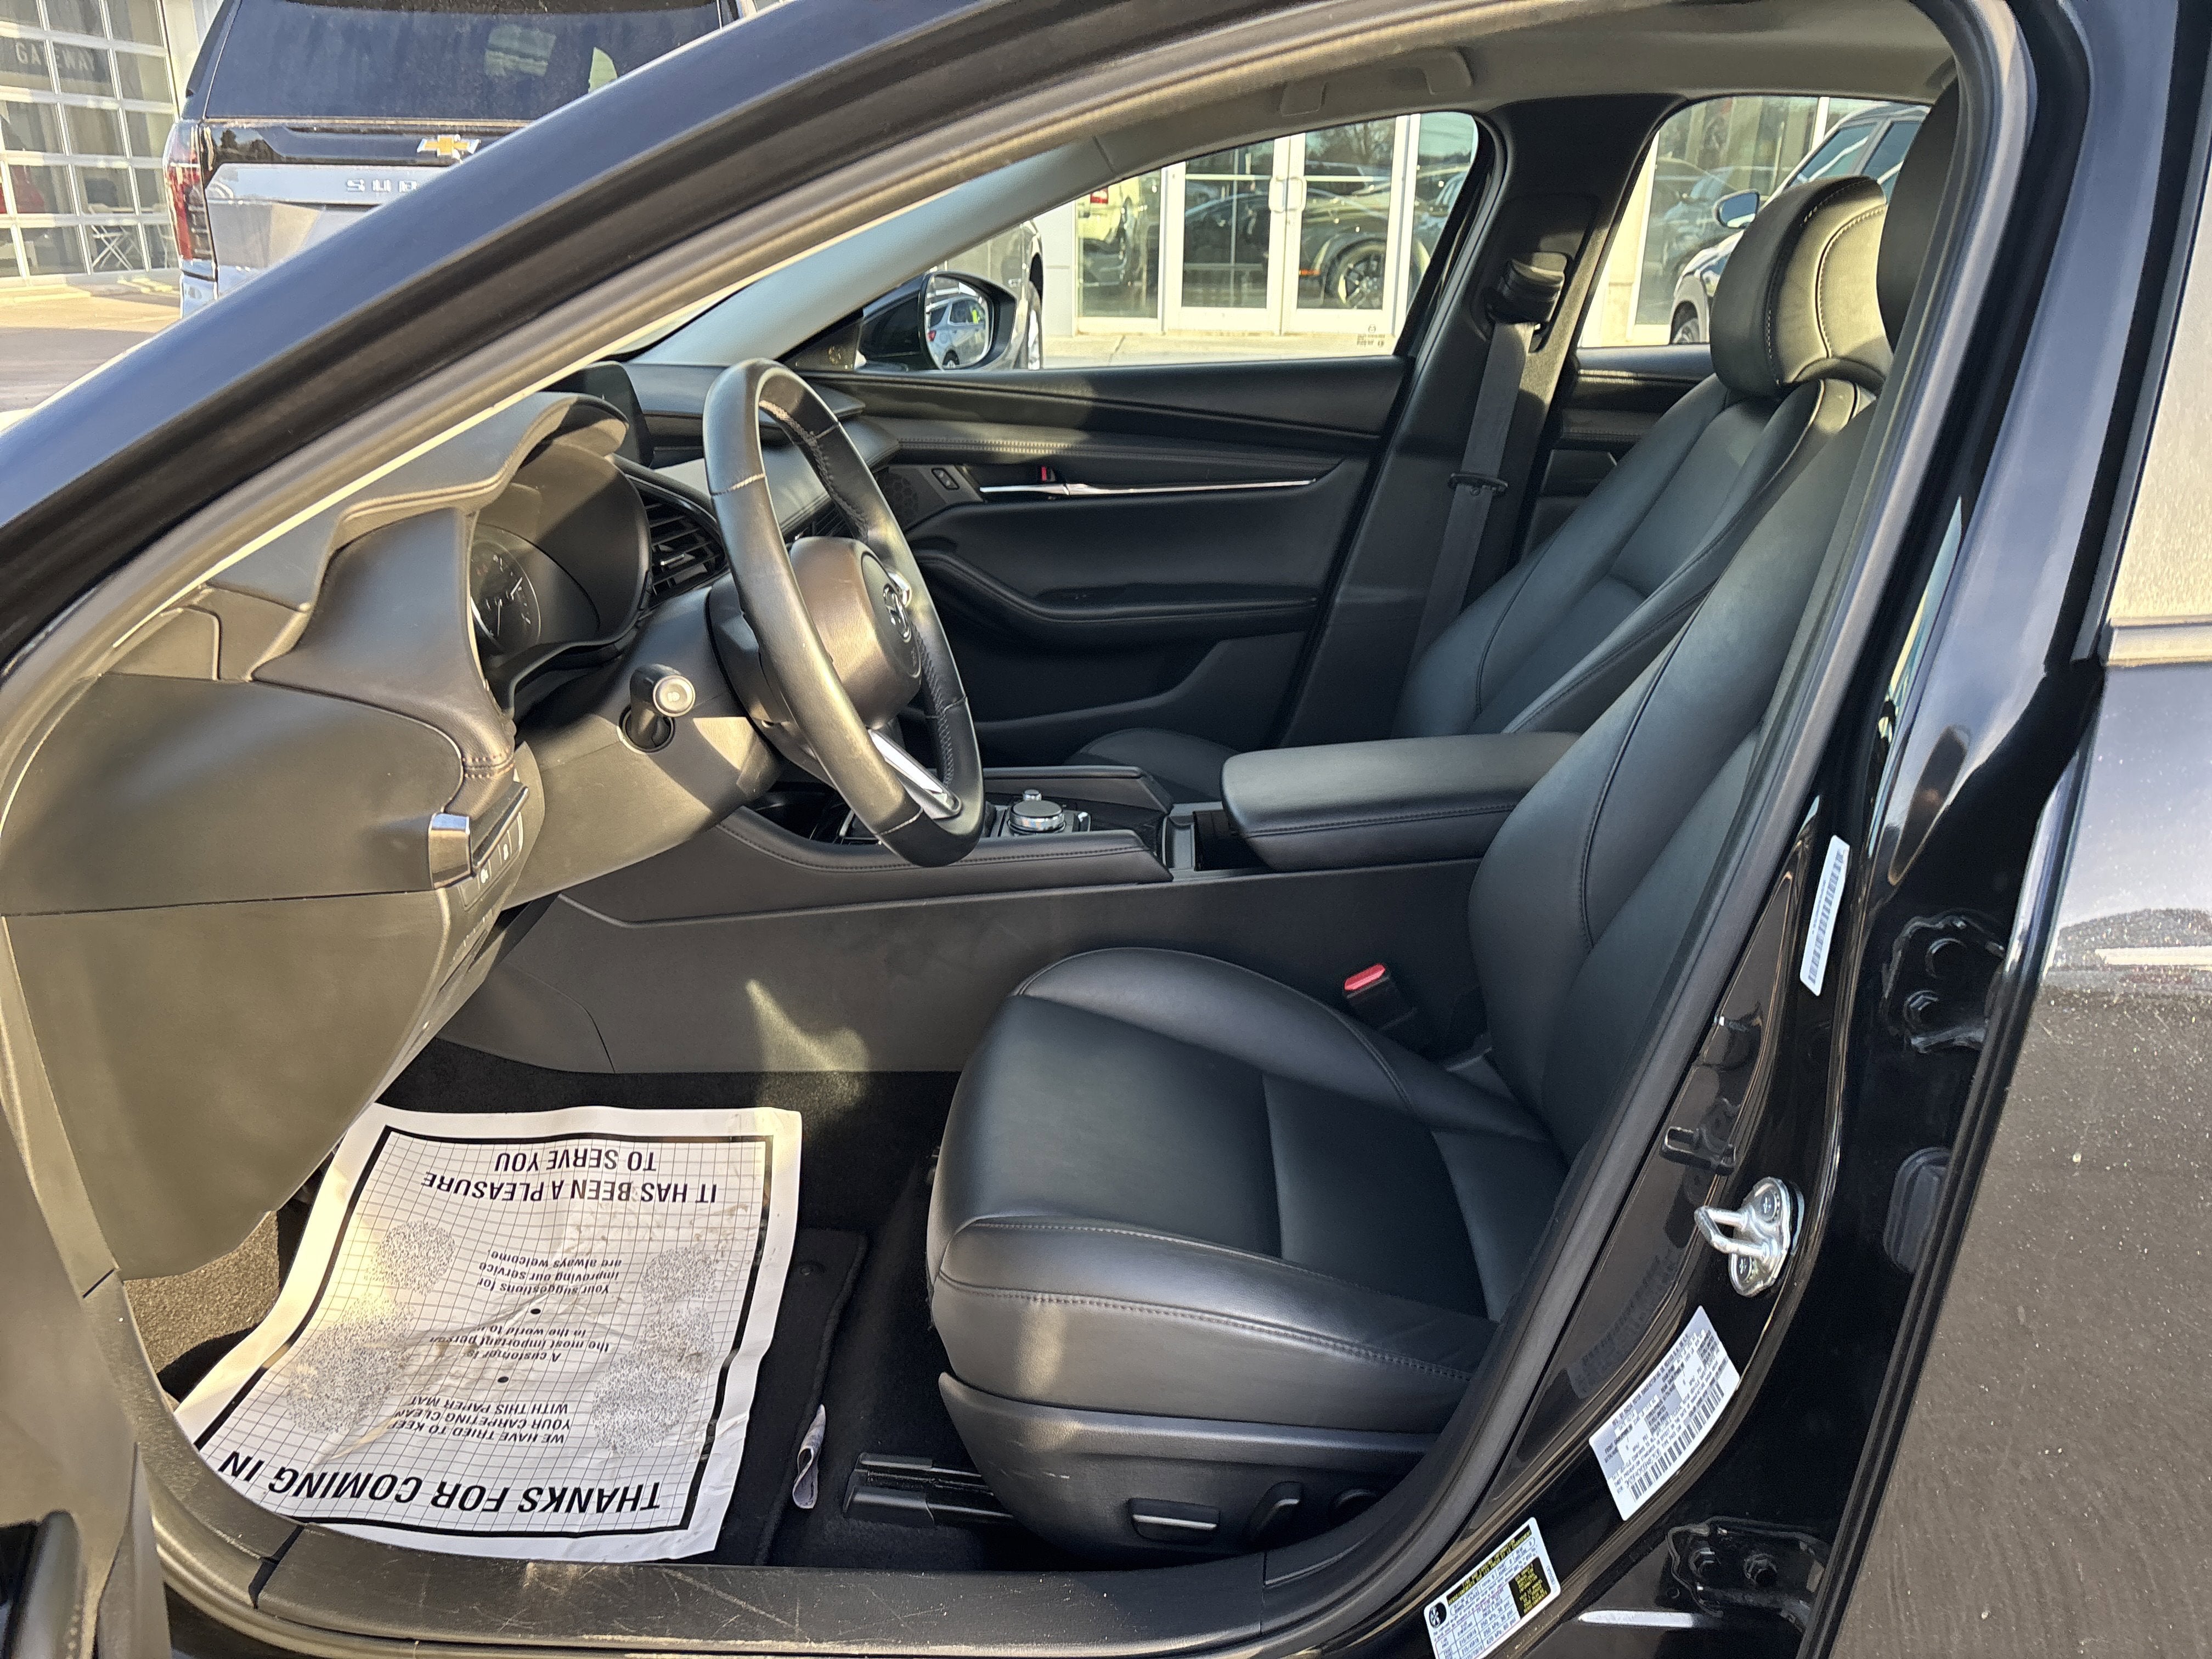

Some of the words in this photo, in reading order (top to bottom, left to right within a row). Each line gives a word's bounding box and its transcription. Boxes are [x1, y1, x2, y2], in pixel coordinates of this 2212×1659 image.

[15, 41, 95, 72] GAEWAY
[493, 1152, 539, 1172] YOU
[546, 1148, 619, 1170] SERVE
[628, 1151, 657, 1171] TO
[420, 1171, 544, 1201] PLEASURE
[551, 1180, 565, 1200] A
[570, 1180, 631, 1201] BEEN
[640, 1182, 688, 1202] HAS
[695, 1184, 717, 1203] IT
[553, 1258, 597, 1268] always
[602, 1259, 622, 1268] are
[479, 1263, 527, 1279] service
[529, 1272, 551, 1281] our
[556, 1271, 619, 1283] improving
[477, 1278, 496, 1290] for
[500, 1283, 579, 1295] suggestions
[582, 1285, 609, 1295] Your
[490, 1325, 503, 1335] to
[506, 1327, 544, 1337] world
[548, 1329, 569, 1338] the
[574, 1330, 586, 1338] in
[430, 1336, 477, 1344] person
[479, 1336, 546, 1350] important
[589, 1342, 609, 1352] the
[482, 1350, 547, 1359] customer
[552, 1353, 561, 1362] A
[408, 1396, 441, 1407] MAT
[444, 1400, 491, 1412] PAPER
[394, 1408, 441, 1420] CLEAN
[496, 1404, 528, 1414] THIS
[532, 1403, 568, 1414] WITH
[387, 1419, 425, 1431] KEEP
[445, 1412, 527, 1428] CARPETING
[533, 1419, 571, 1430] YOUR
[429, 1424, 447, 1435] TO
[453, 1427, 494, 1440] TRIED
[500, 1432, 538, 1442] HAVE
[541, 1435, 565, 1443] WE
[218, 1450, 263, 1485] IN
[268, 1467, 421, 1503] COMING
[432, 1481, 510, 1511] FOR
[518, 1482, 661, 1513] THANKS
